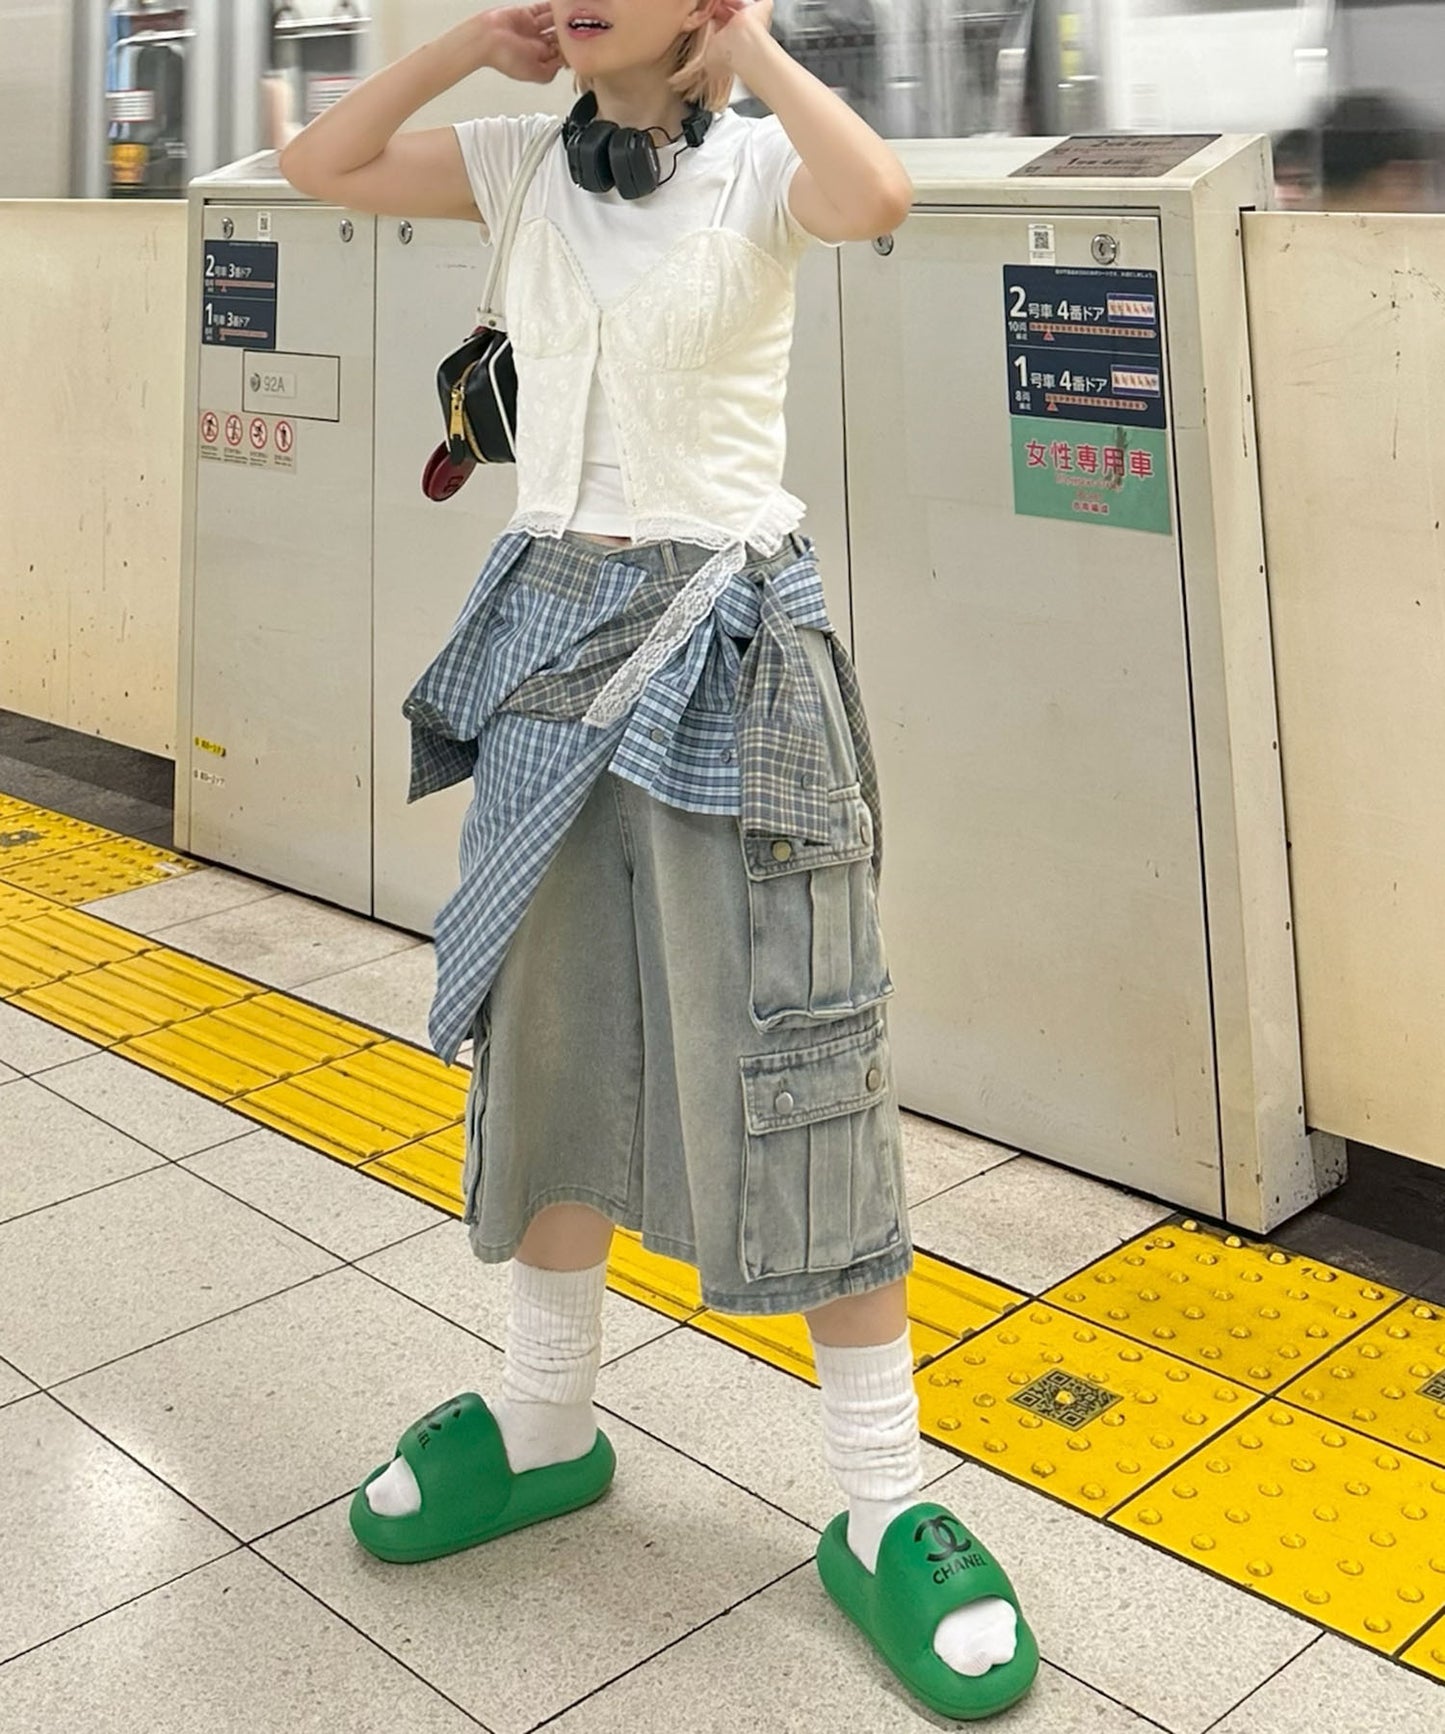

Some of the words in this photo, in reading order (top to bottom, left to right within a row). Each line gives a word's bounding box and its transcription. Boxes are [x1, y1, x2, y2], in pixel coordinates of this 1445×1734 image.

[1009, 285, 1053, 319] 2号車
[1057, 300, 1105, 322] 4番ドア
[263, 375, 286, 393] 92A
[1014, 355, 1056, 389] 1号車
[1059, 370, 1108, 393] 4番ドア
[1025, 440, 1154, 479] 女性専用車
[933, 1554, 987, 1584] CHANEL
